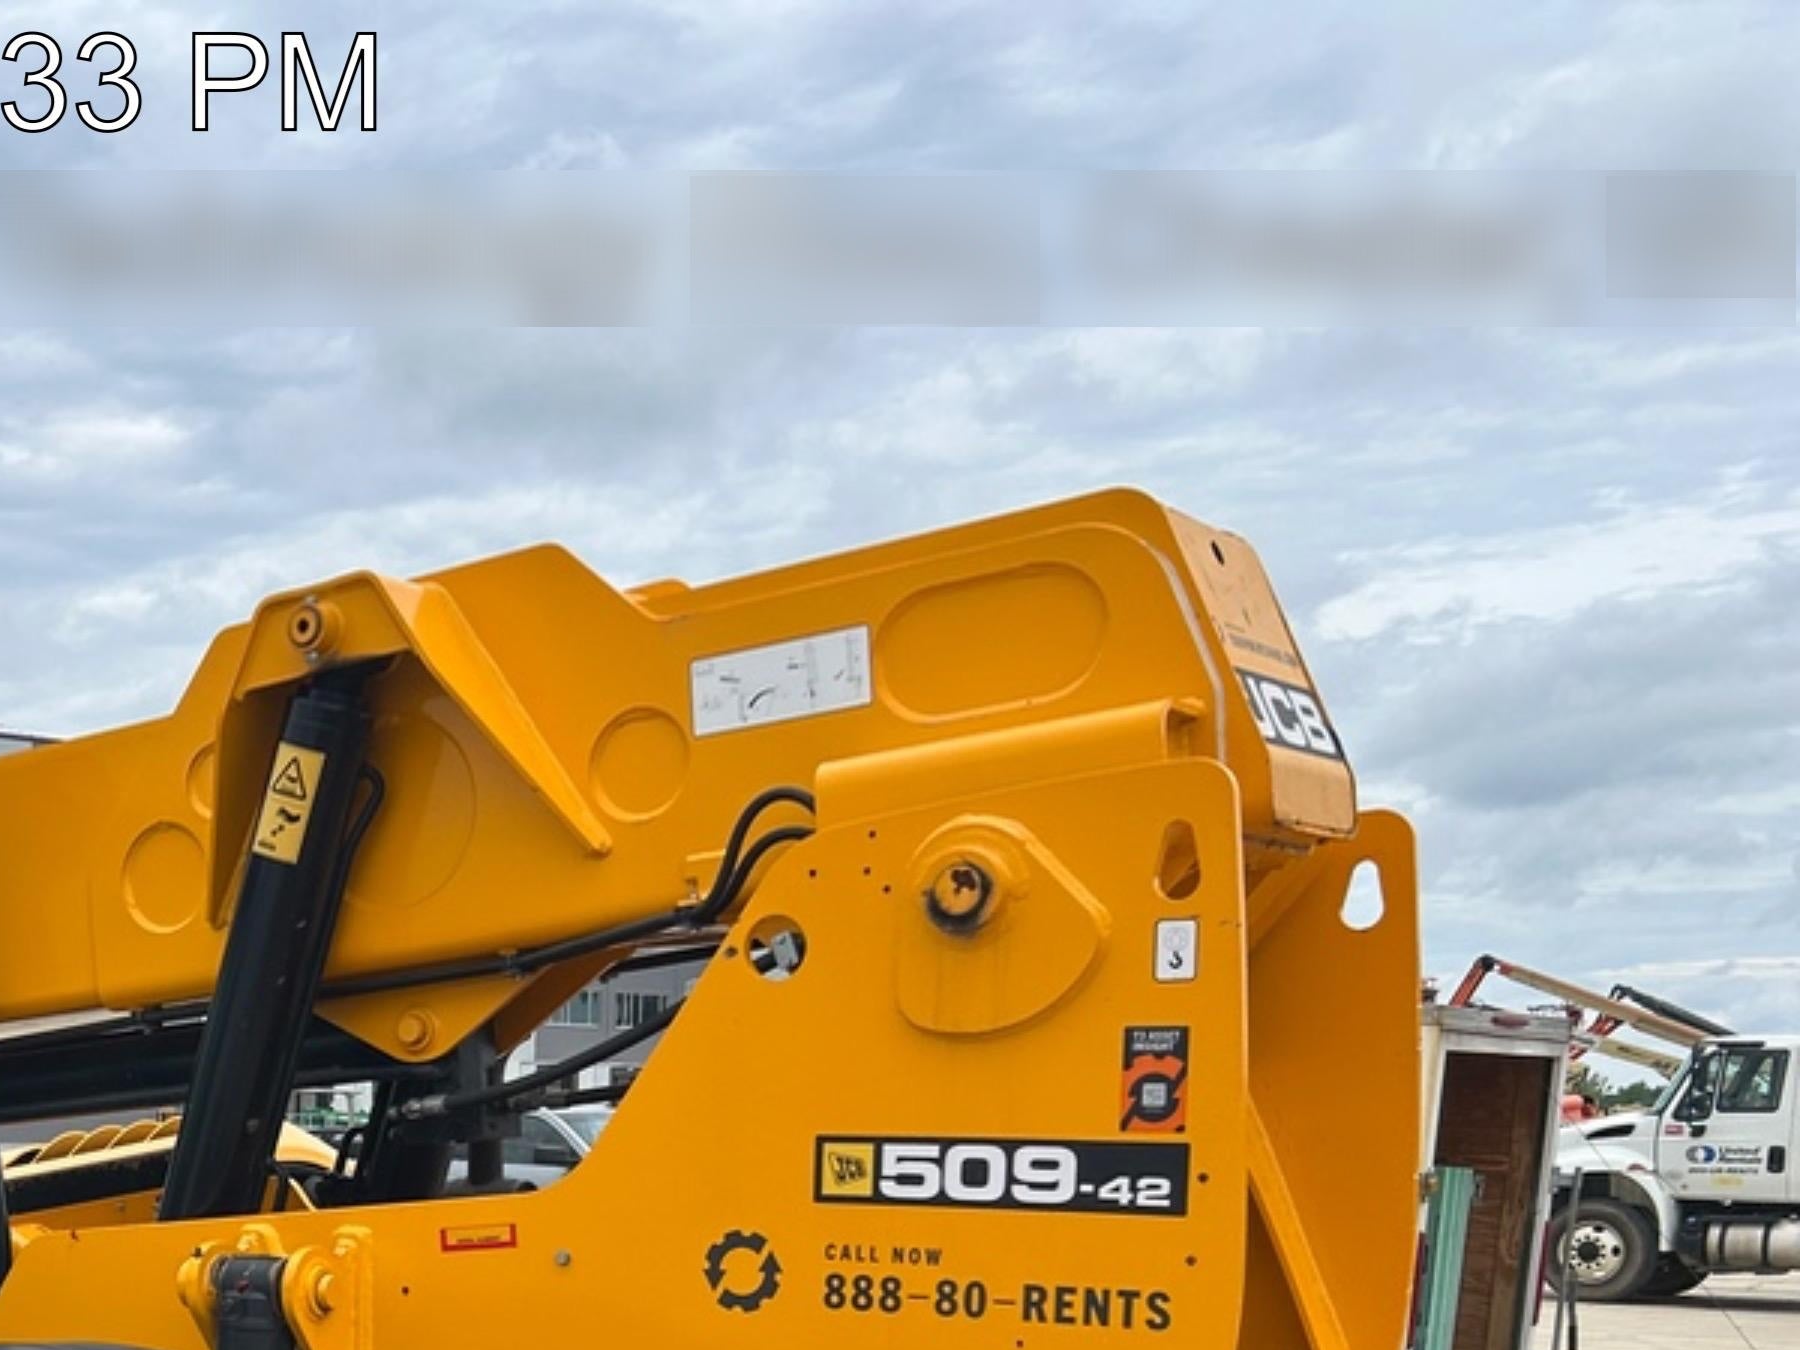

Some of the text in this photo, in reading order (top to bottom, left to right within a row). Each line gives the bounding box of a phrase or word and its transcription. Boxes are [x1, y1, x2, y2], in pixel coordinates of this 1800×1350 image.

[1245, 675, 1337, 753] JCB
[878, 1142, 1172, 1207] 509-42
[824, 1243, 943, 1267] CALL NOW
[823, 1272, 1172, 1331] 888-80-RENTS
